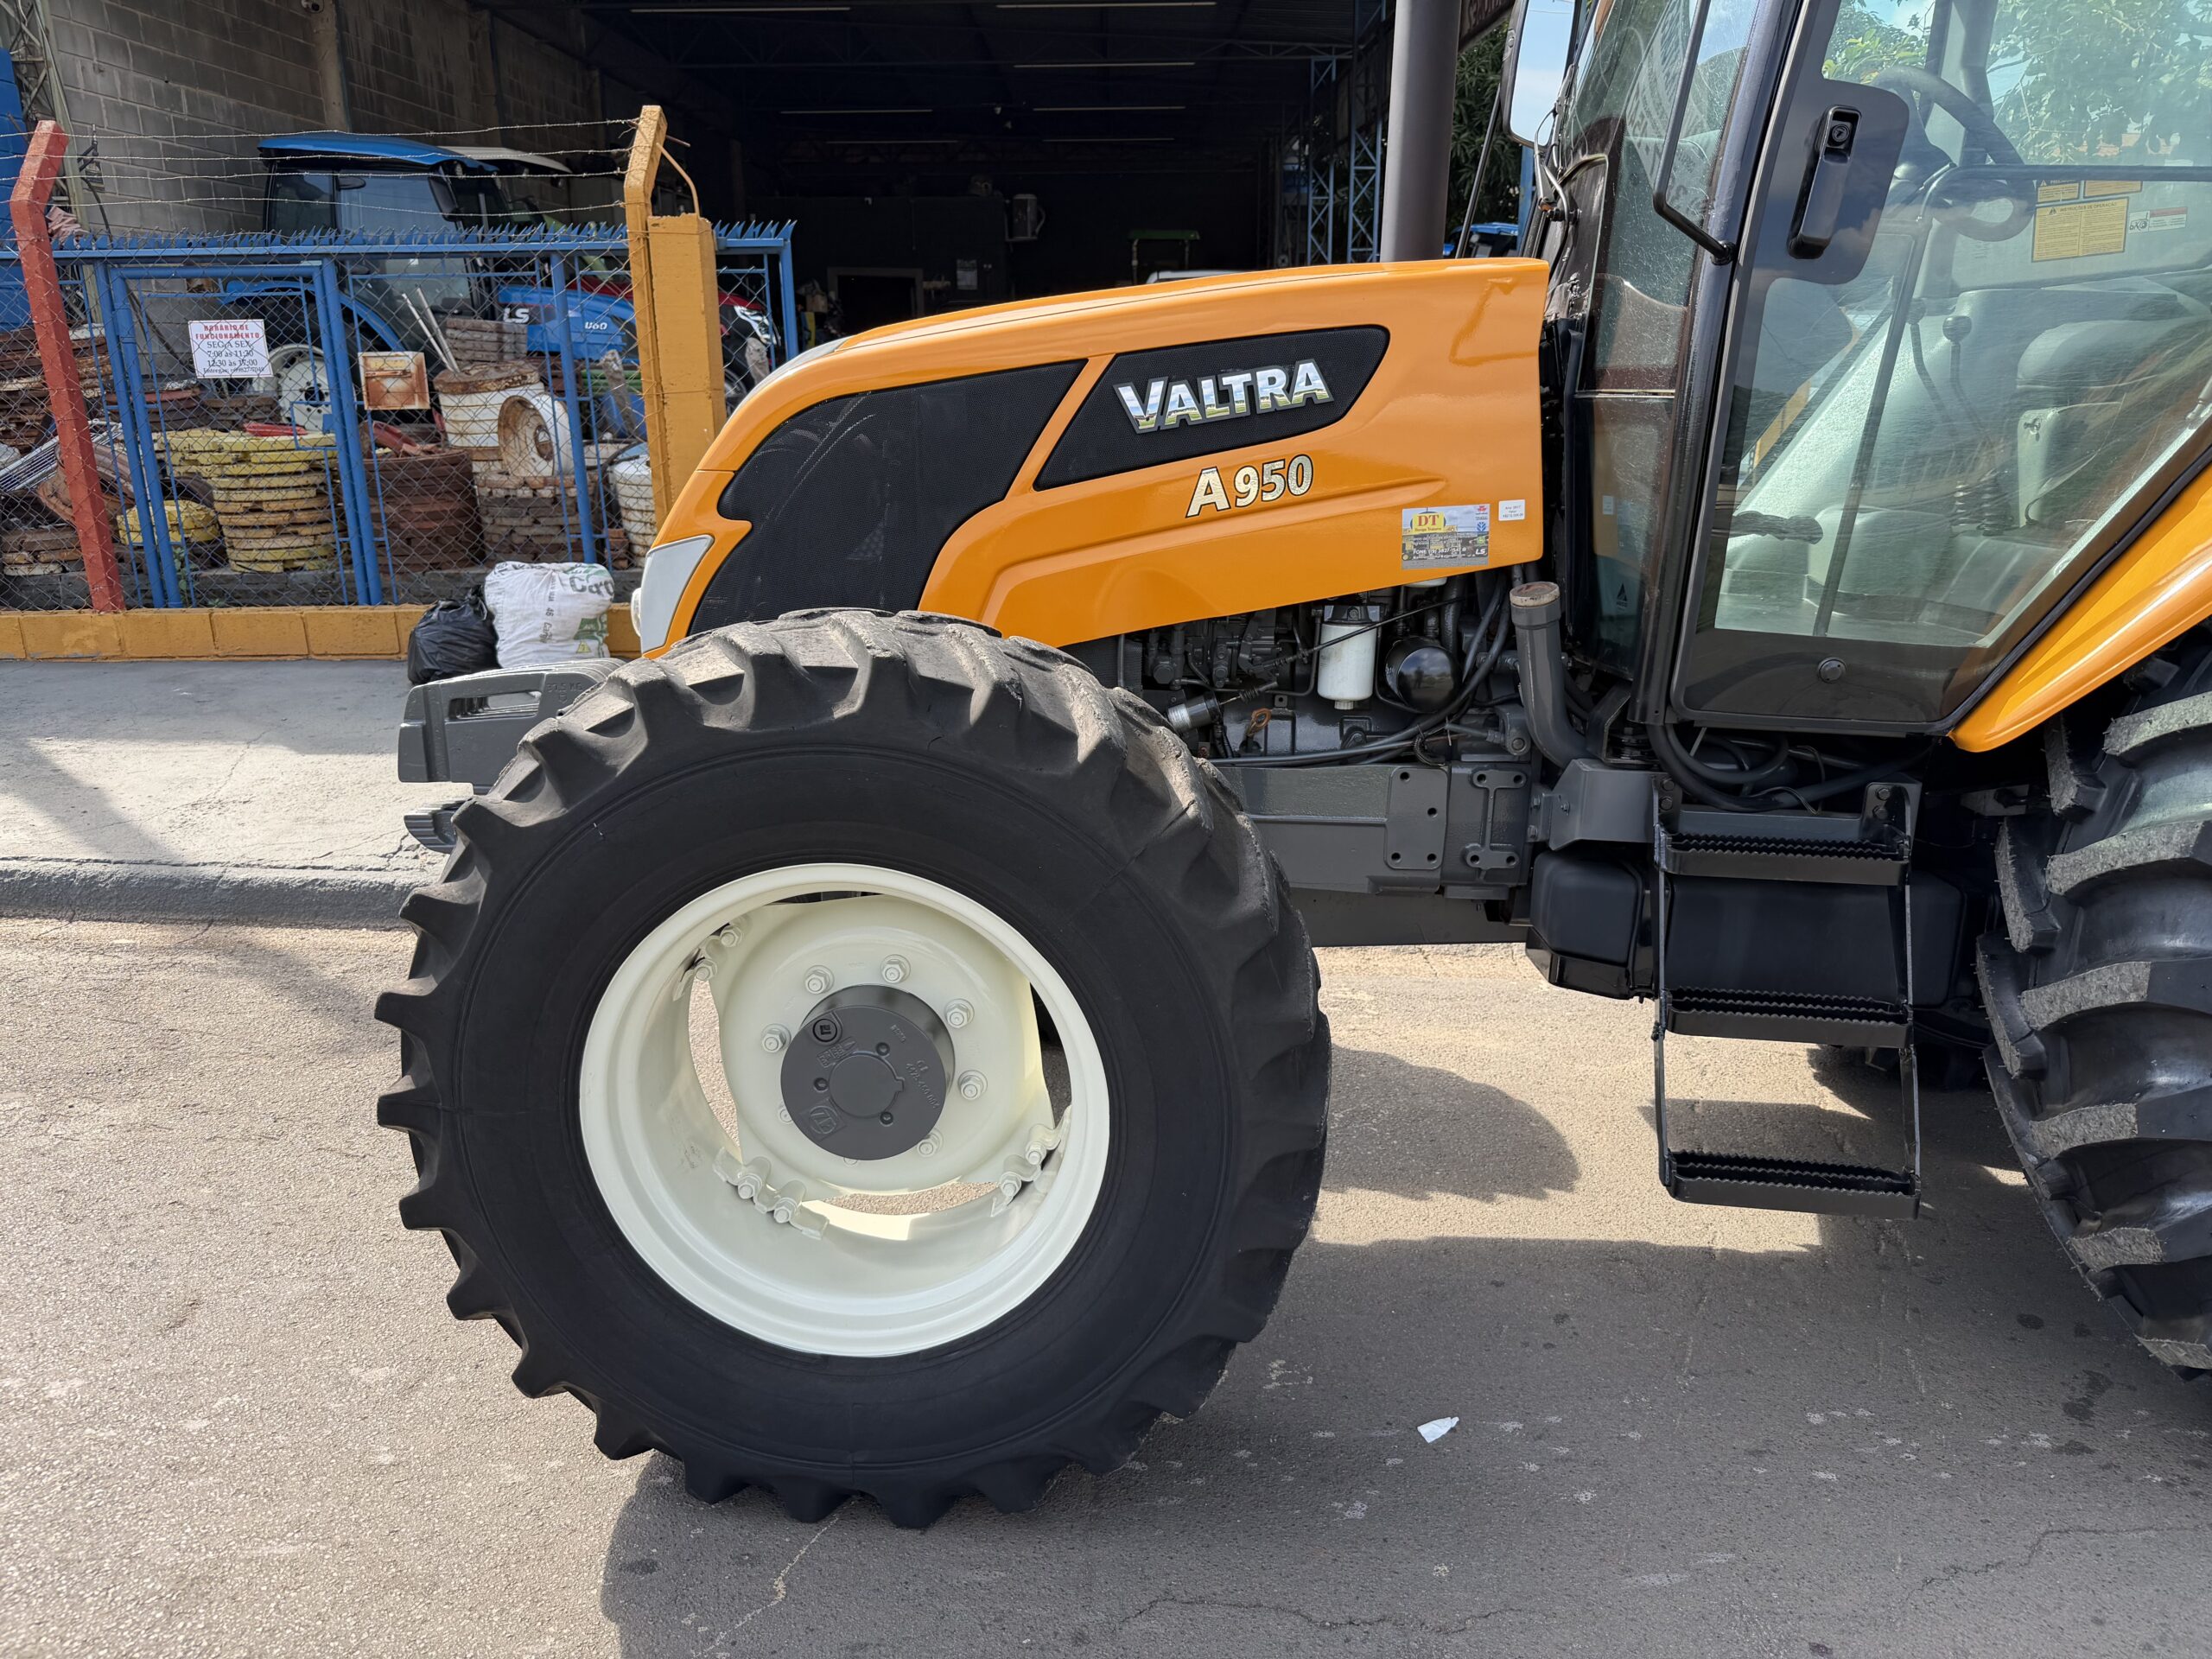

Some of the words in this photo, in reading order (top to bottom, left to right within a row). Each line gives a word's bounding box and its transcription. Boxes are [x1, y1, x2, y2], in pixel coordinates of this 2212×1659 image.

[503, 308, 530, 324] LS
[1113, 358, 1334, 434] VALTRA
[1185, 466, 1231, 518] A
[1233, 454, 1313, 508] 950
[1417, 514, 1440, 526] DT
